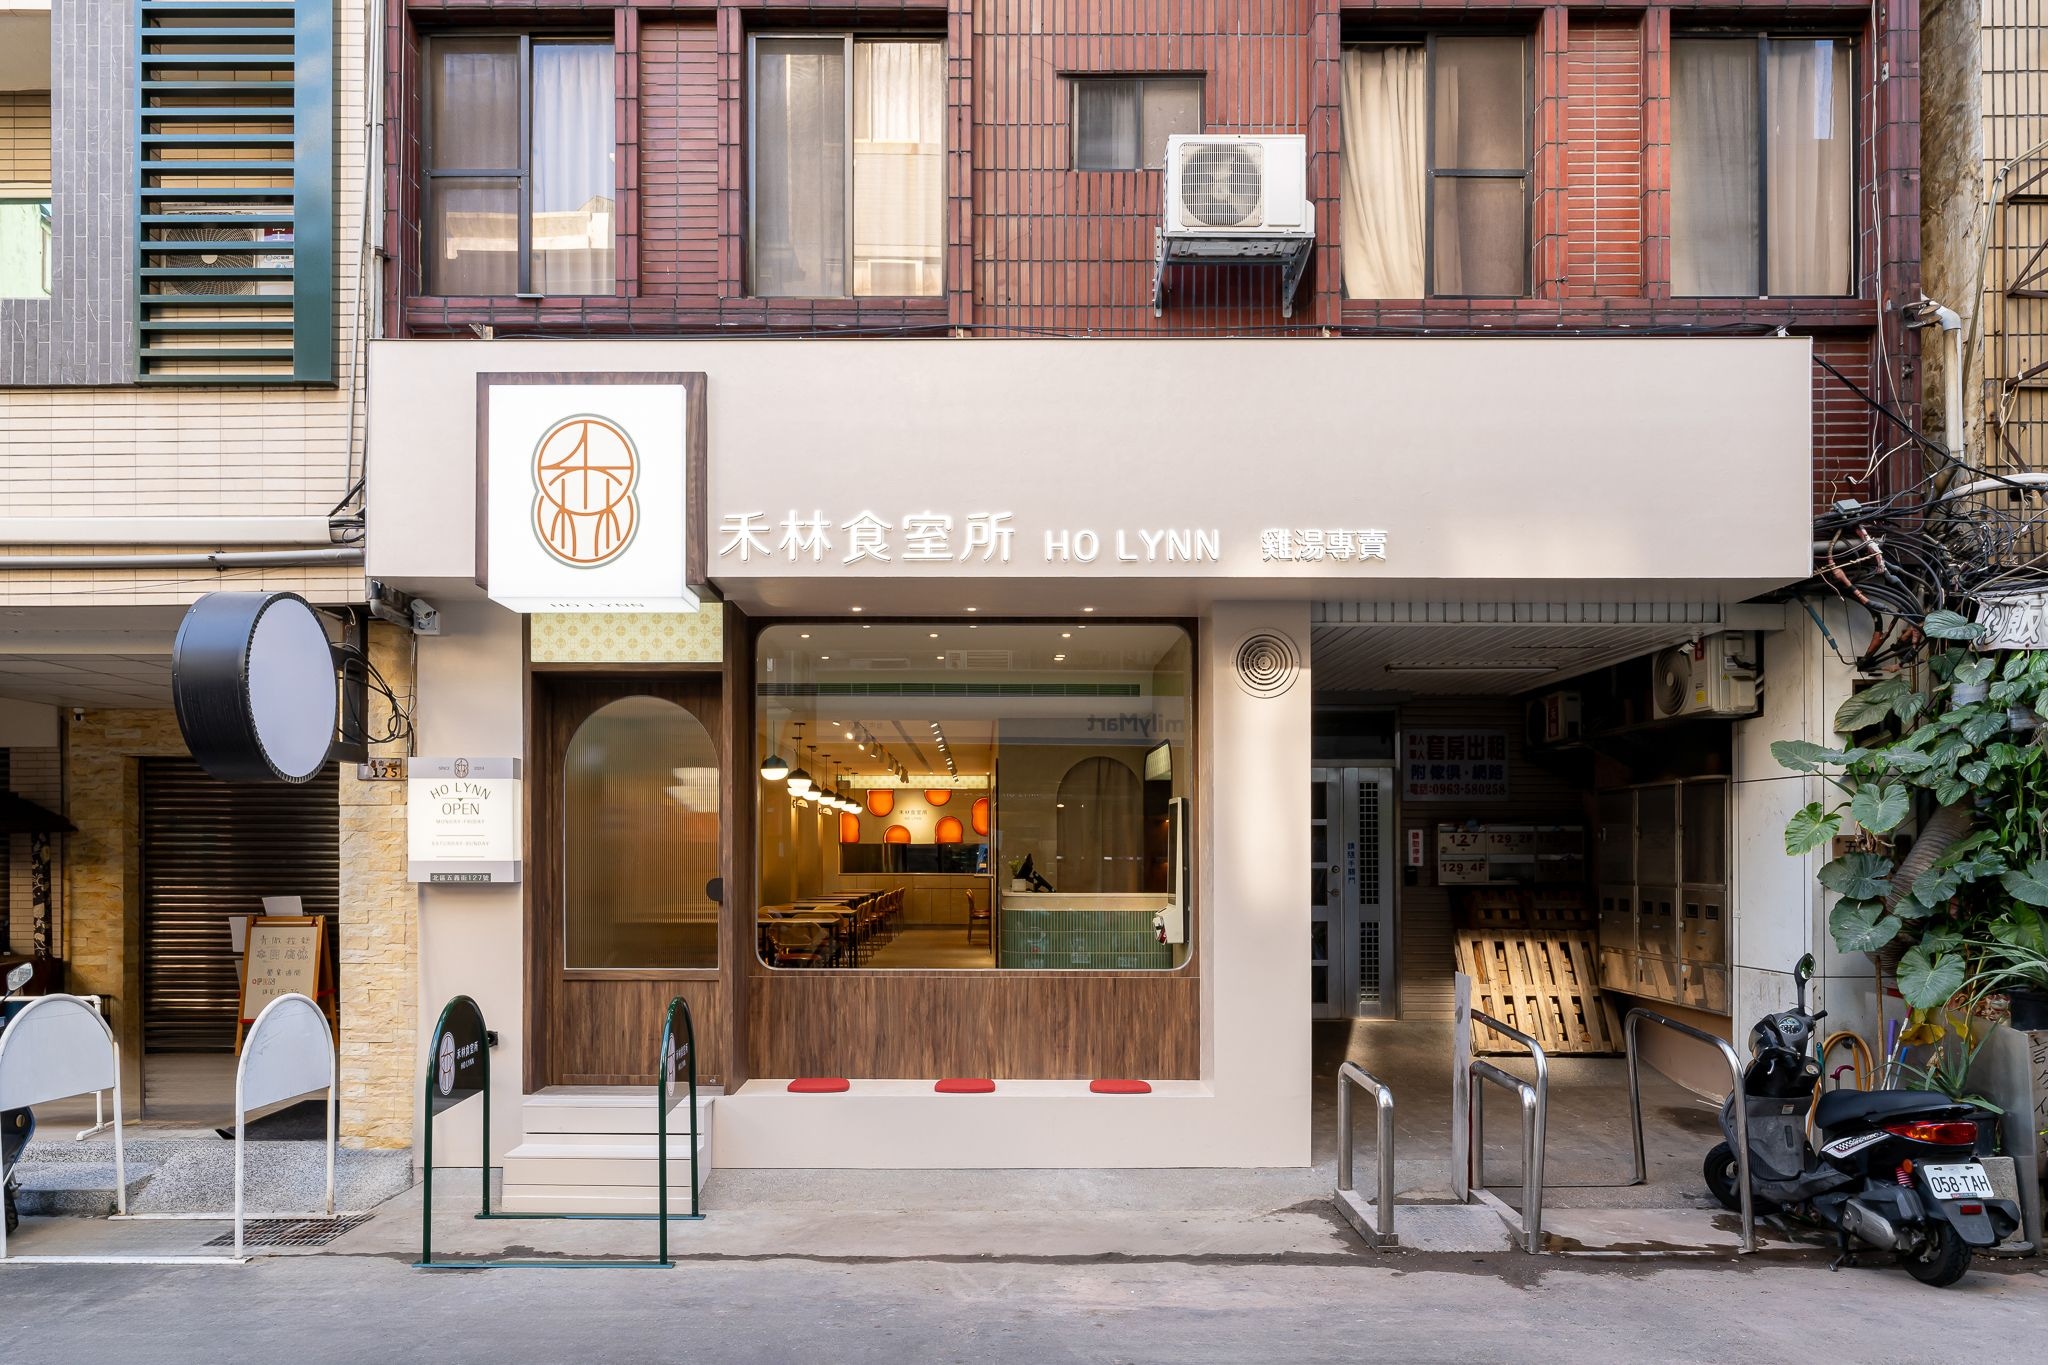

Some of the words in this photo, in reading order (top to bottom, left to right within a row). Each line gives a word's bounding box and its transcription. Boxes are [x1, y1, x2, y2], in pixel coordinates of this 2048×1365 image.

[719, 509, 1015, 565] 禾林食室所
[1044, 528, 1099, 563] HO
[1115, 528, 1220, 563] LYNN
[1261, 527, 1388, 563] 雞湯專賣
[1427, 735, 1505, 760] 套房出租
[373, 767, 398, 778] 125
[430, 784, 449, 800] HO
[455, 782, 492, 800] LYNN
[442, 803, 480, 815] OPEN
[1449, 834, 1478, 844] 127
